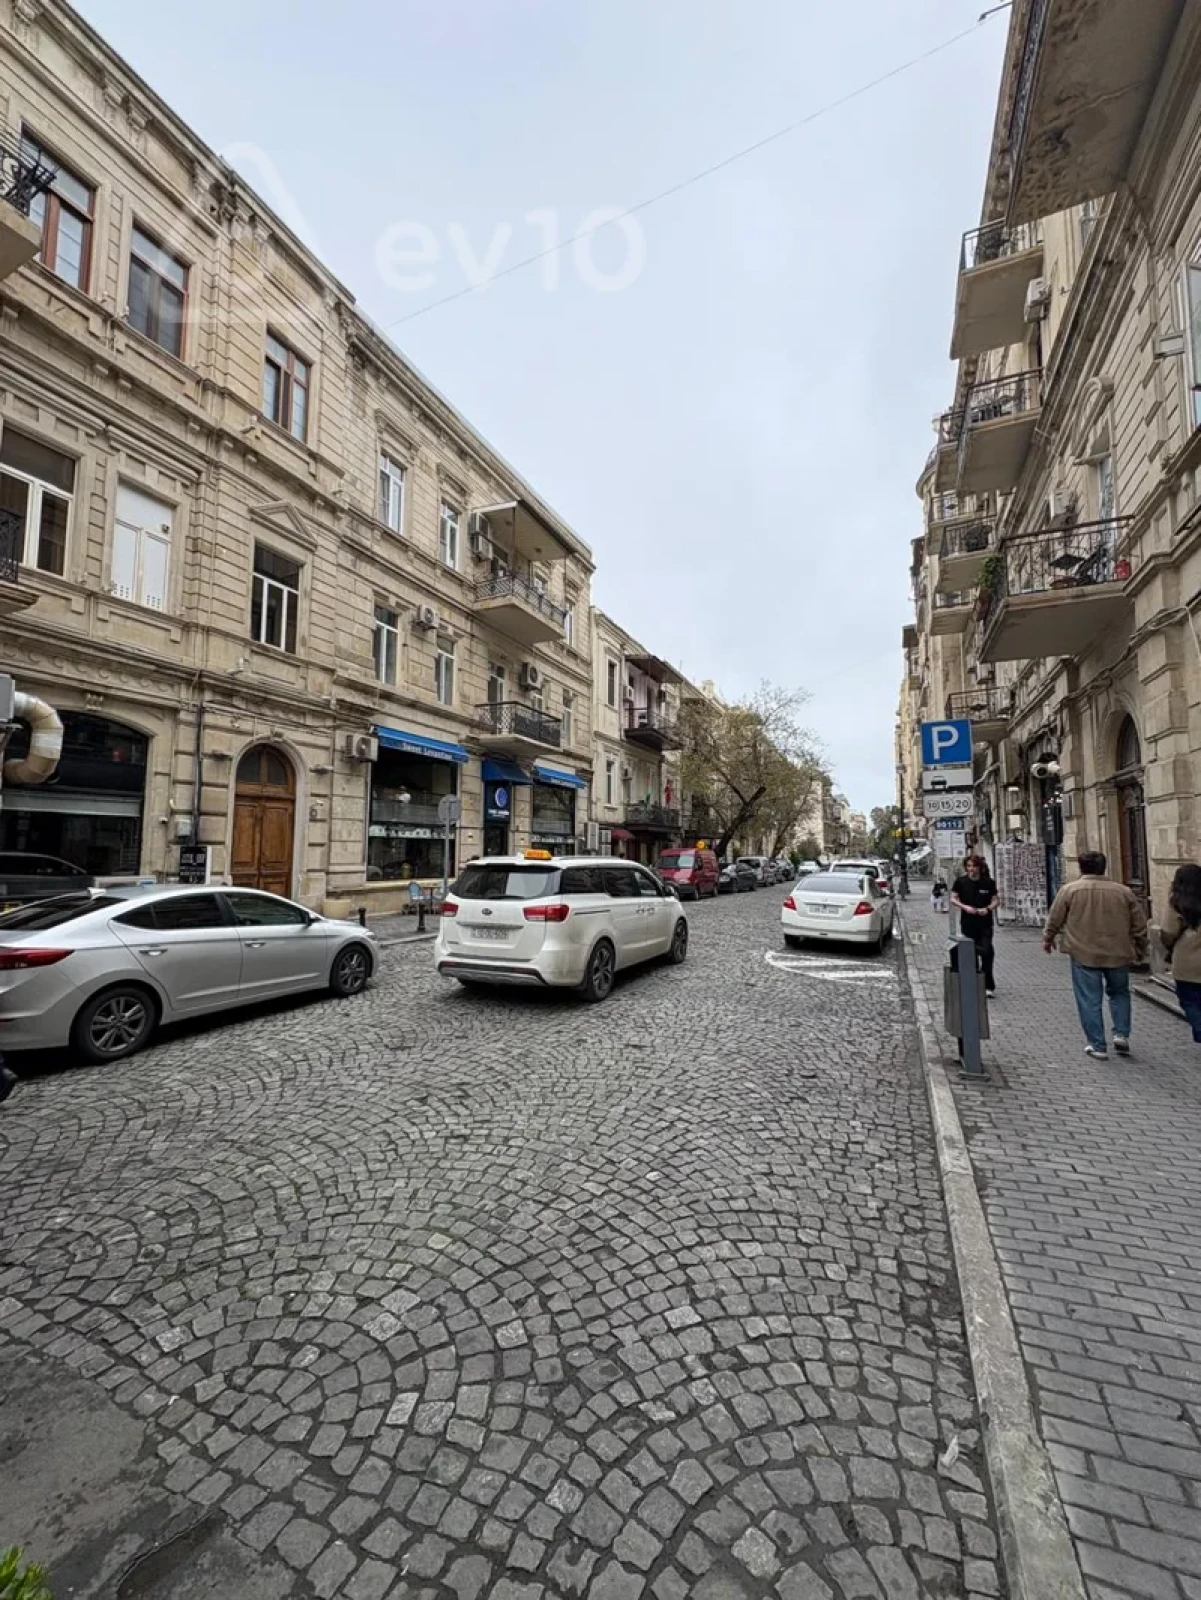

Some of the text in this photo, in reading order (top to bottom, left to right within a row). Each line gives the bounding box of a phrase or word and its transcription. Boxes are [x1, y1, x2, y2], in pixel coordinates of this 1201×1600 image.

[931, 725, 959, 760] P
[941, 801, 951, 809] 15
[955, 800, 969, 808] 20
